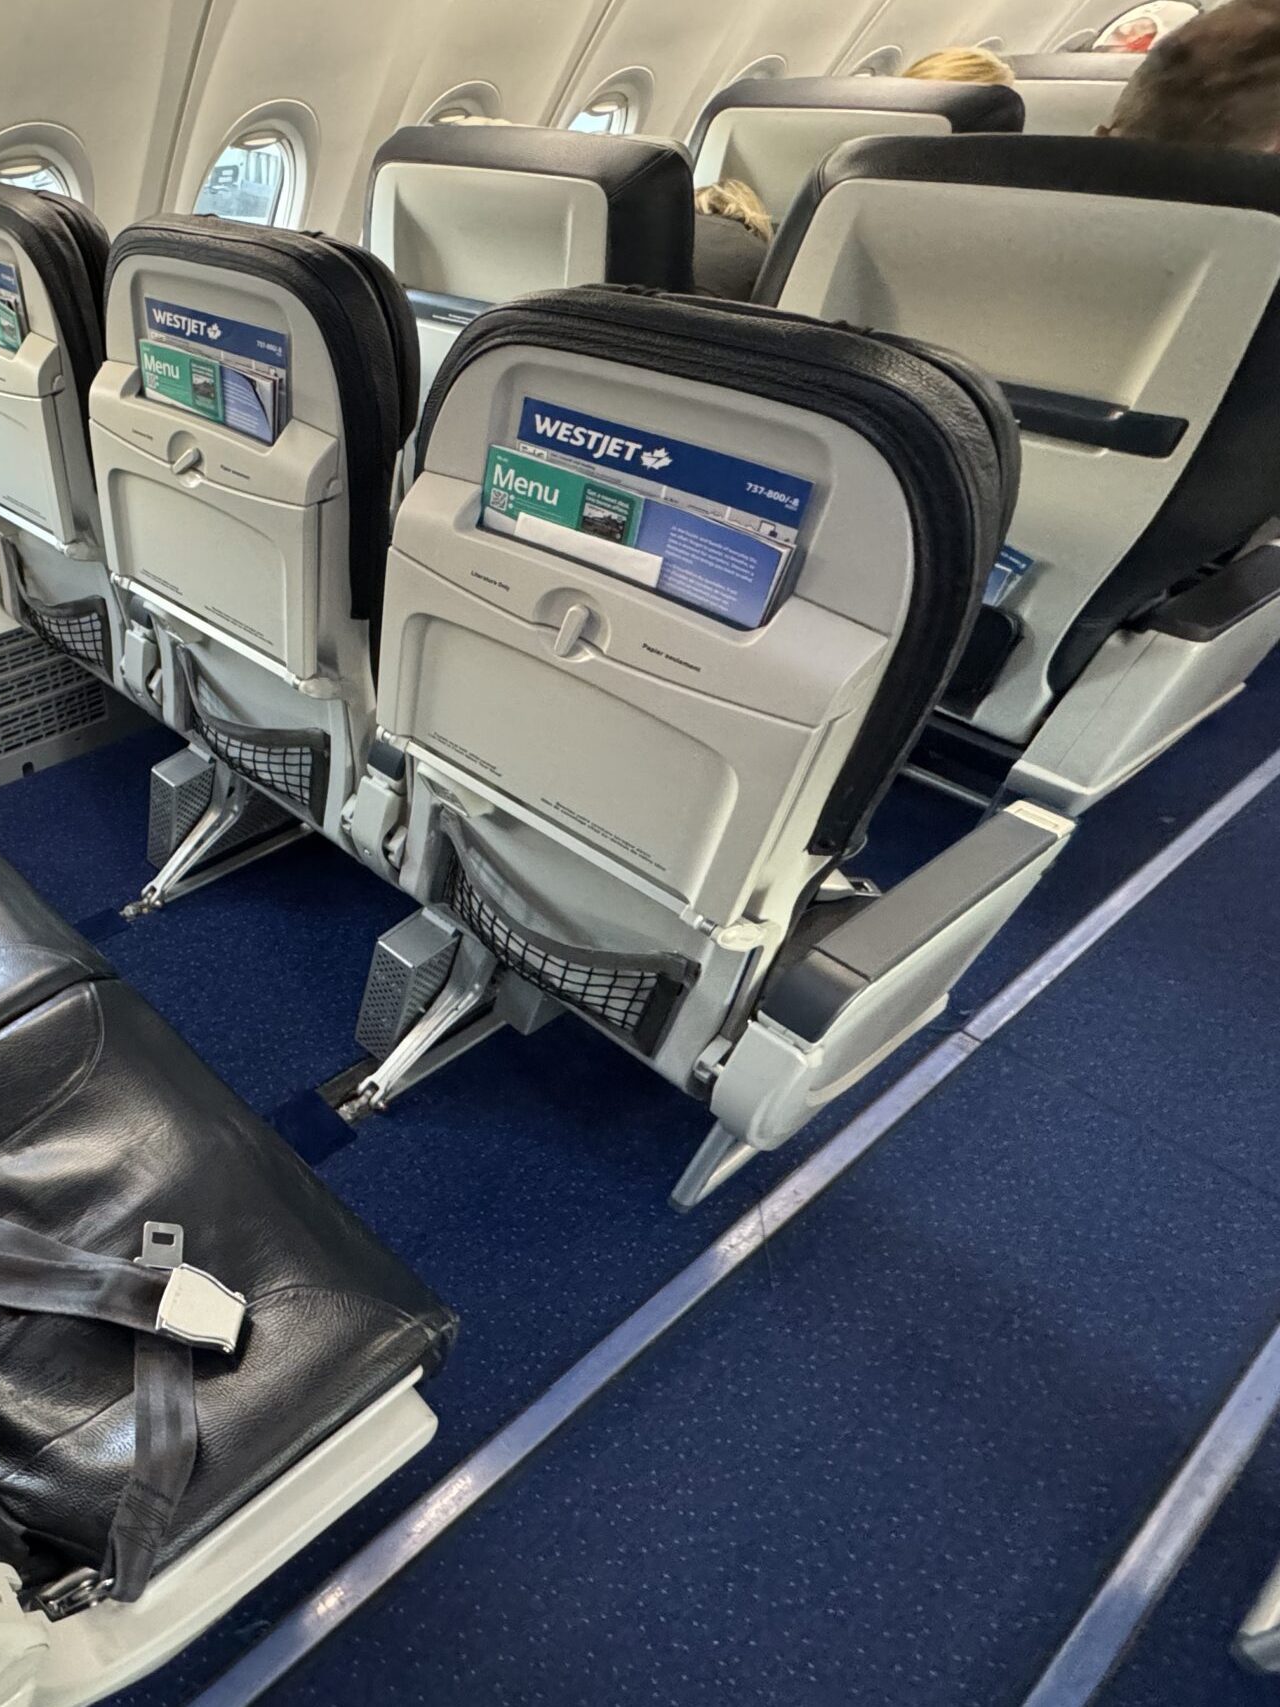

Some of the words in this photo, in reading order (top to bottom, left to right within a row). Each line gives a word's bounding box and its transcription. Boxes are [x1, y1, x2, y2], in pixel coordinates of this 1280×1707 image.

[152, 308, 207, 336] WESTJET
[144, 353, 180, 379] Menu
[534, 414, 644, 463] WESTJET
[492, 464, 560, 507] Menu
[746, 482, 800, 507] 737-800/-8
[642, 642, 663, 656] Papier
[665, 653, 701, 672] seulement
